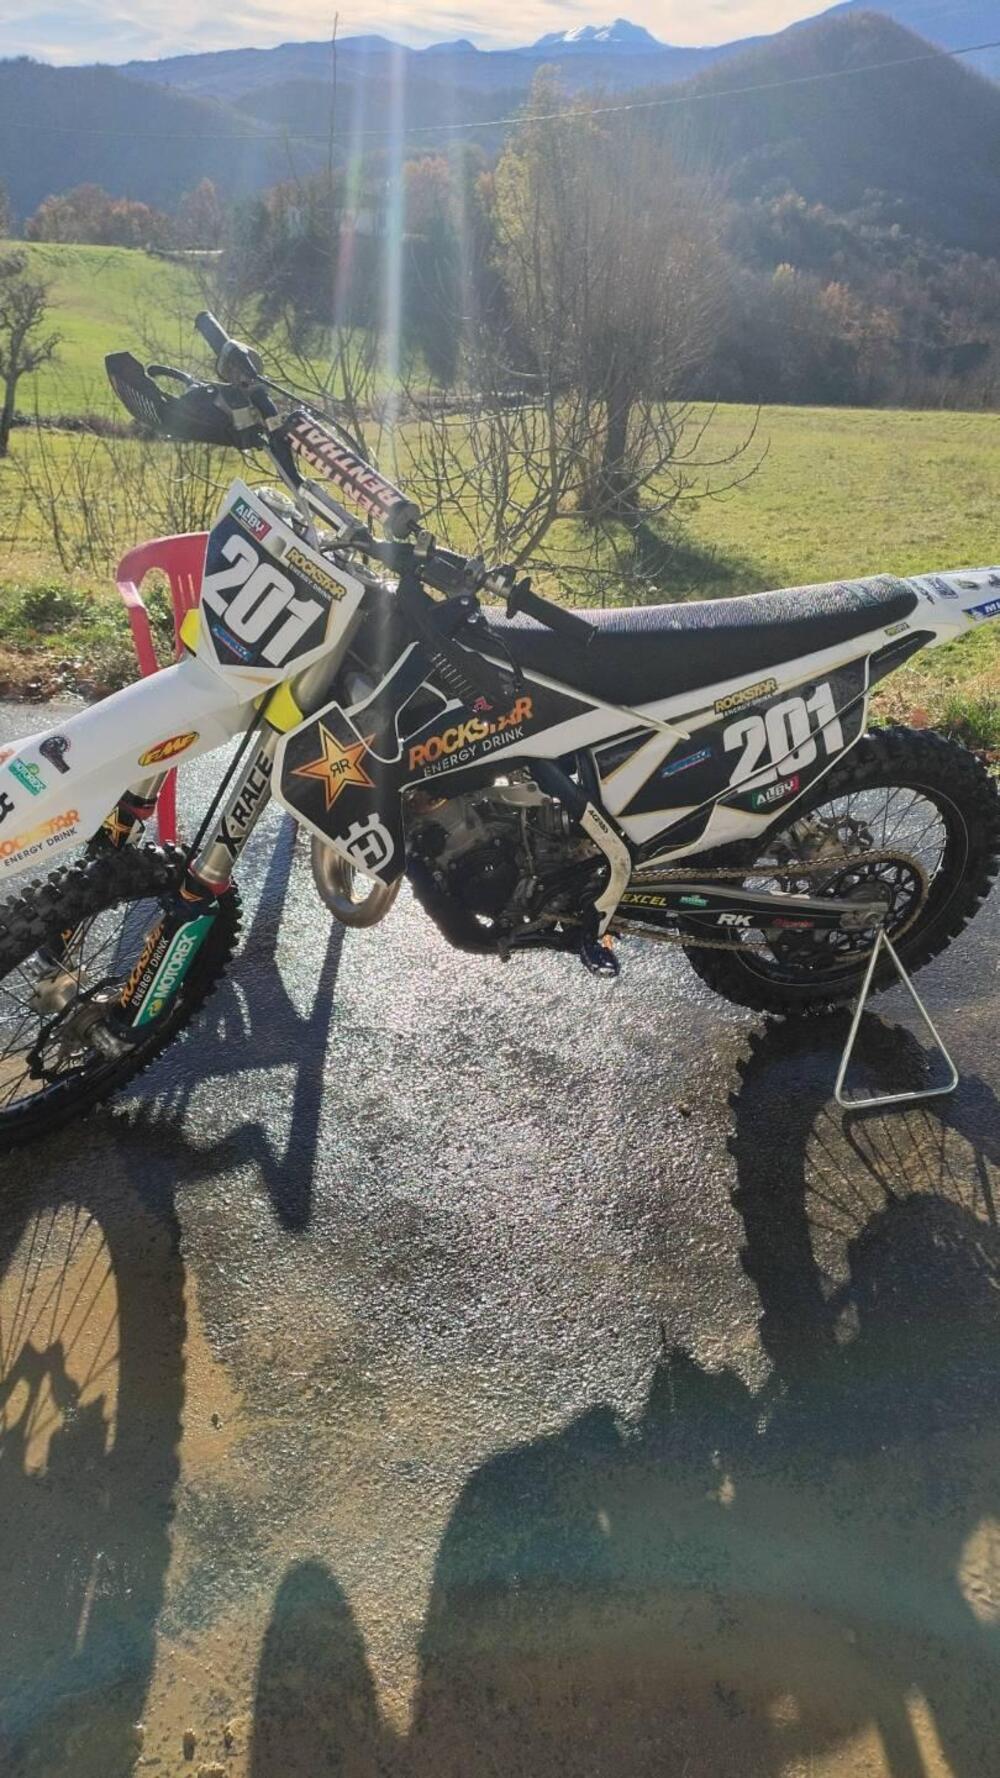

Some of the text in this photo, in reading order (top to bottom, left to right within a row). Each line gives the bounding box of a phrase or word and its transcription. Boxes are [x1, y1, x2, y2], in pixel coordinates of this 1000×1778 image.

[295, 417, 402, 506] RENTHAL
[203, 534, 324, 666] 201
[286, 547, 346, 600] ROCKSTAR
[715, 678, 778, 713] ROCKSTAR
[423, 726, 525, 777] ENERGY DRINK
[723, 682, 844, 793] 201
[4, 827, 77, 867] ENERGY DRINK
[622, 893, 668, 907] EXCEL
[717, 913, 754, 926] RK
[131, 937, 170, 1007] ENERGY DRINK
[154, 933, 198, 998] MOTOREX
